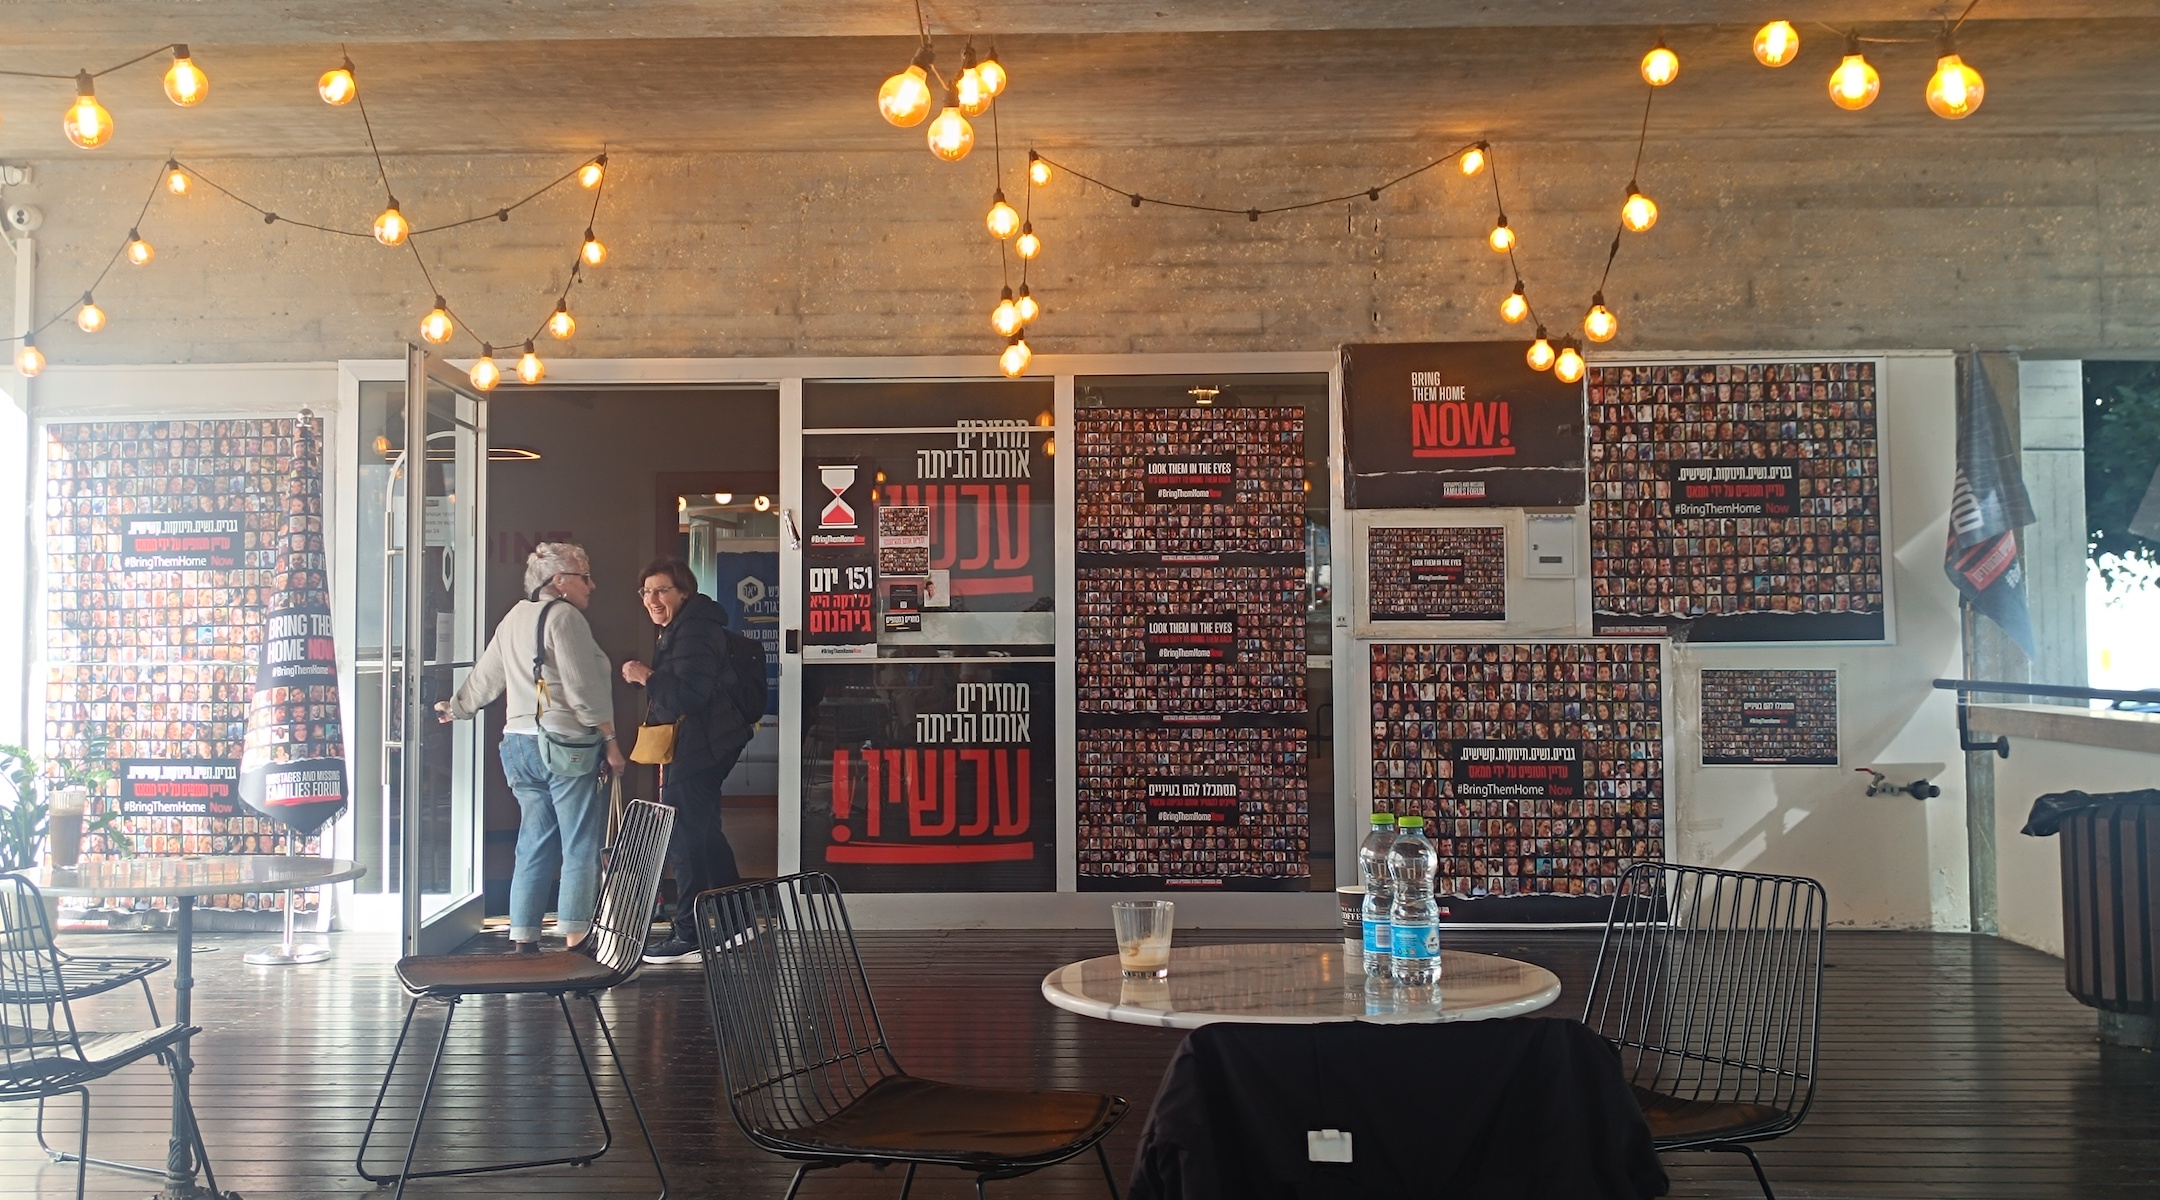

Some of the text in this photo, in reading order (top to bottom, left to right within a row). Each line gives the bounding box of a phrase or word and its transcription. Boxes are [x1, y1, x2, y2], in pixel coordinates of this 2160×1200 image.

[1411, 371, 1440, 386] BRING
[1412, 386, 1465, 401] THEM HOME
[1412, 402, 1511, 447] NOW!
[957, 420, 1030, 448] מחזירים
[917, 450, 1030, 478] אותם הביתה
[1148, 463, 1231, 474] LOOK THEM IN THE EYES
[1444, 486, 1485, 496] FAMILIES FORUM
[1711, 485, 1722, 498] ידי
[1724, 484, 1734, 498] על
[1675, 503, 1790, 516] #BringThemHome Now
[125, 556, 234, 570] #BringThemHome Now
[810, 566, 872, 592] 151 יום
[810, 594, 830, 608] היא
[859, 593, 872, 608] כל
[268, 614, 333, 640] BRING THE
[810, 610, 872, 632] גיהנום
[1150, 622, 1232, 634] LOOK THEM IN THE EYES
[267, 638, 305, 664] HOME
[956, 682, 1030, 712] מחזירים
[916, 713, 1030, 743] אותם הביתה
[302, 771, 316, 782] AND
[1493, 765, 1504, 778] ידי
[1506, 764, 1517, 778] על
[1548, 765, 1568, 779] עדיין
[313, 782, 341, 796] FORUM
[832, 749, 1030, 842] עכשיו!
[1149, 783, 1236, 796] תסתכלו להם בעיניים
[1457, 784, 1573, 798] #BringThemHome Now
[124, 801, 233, 814] #BringThemHome Now
